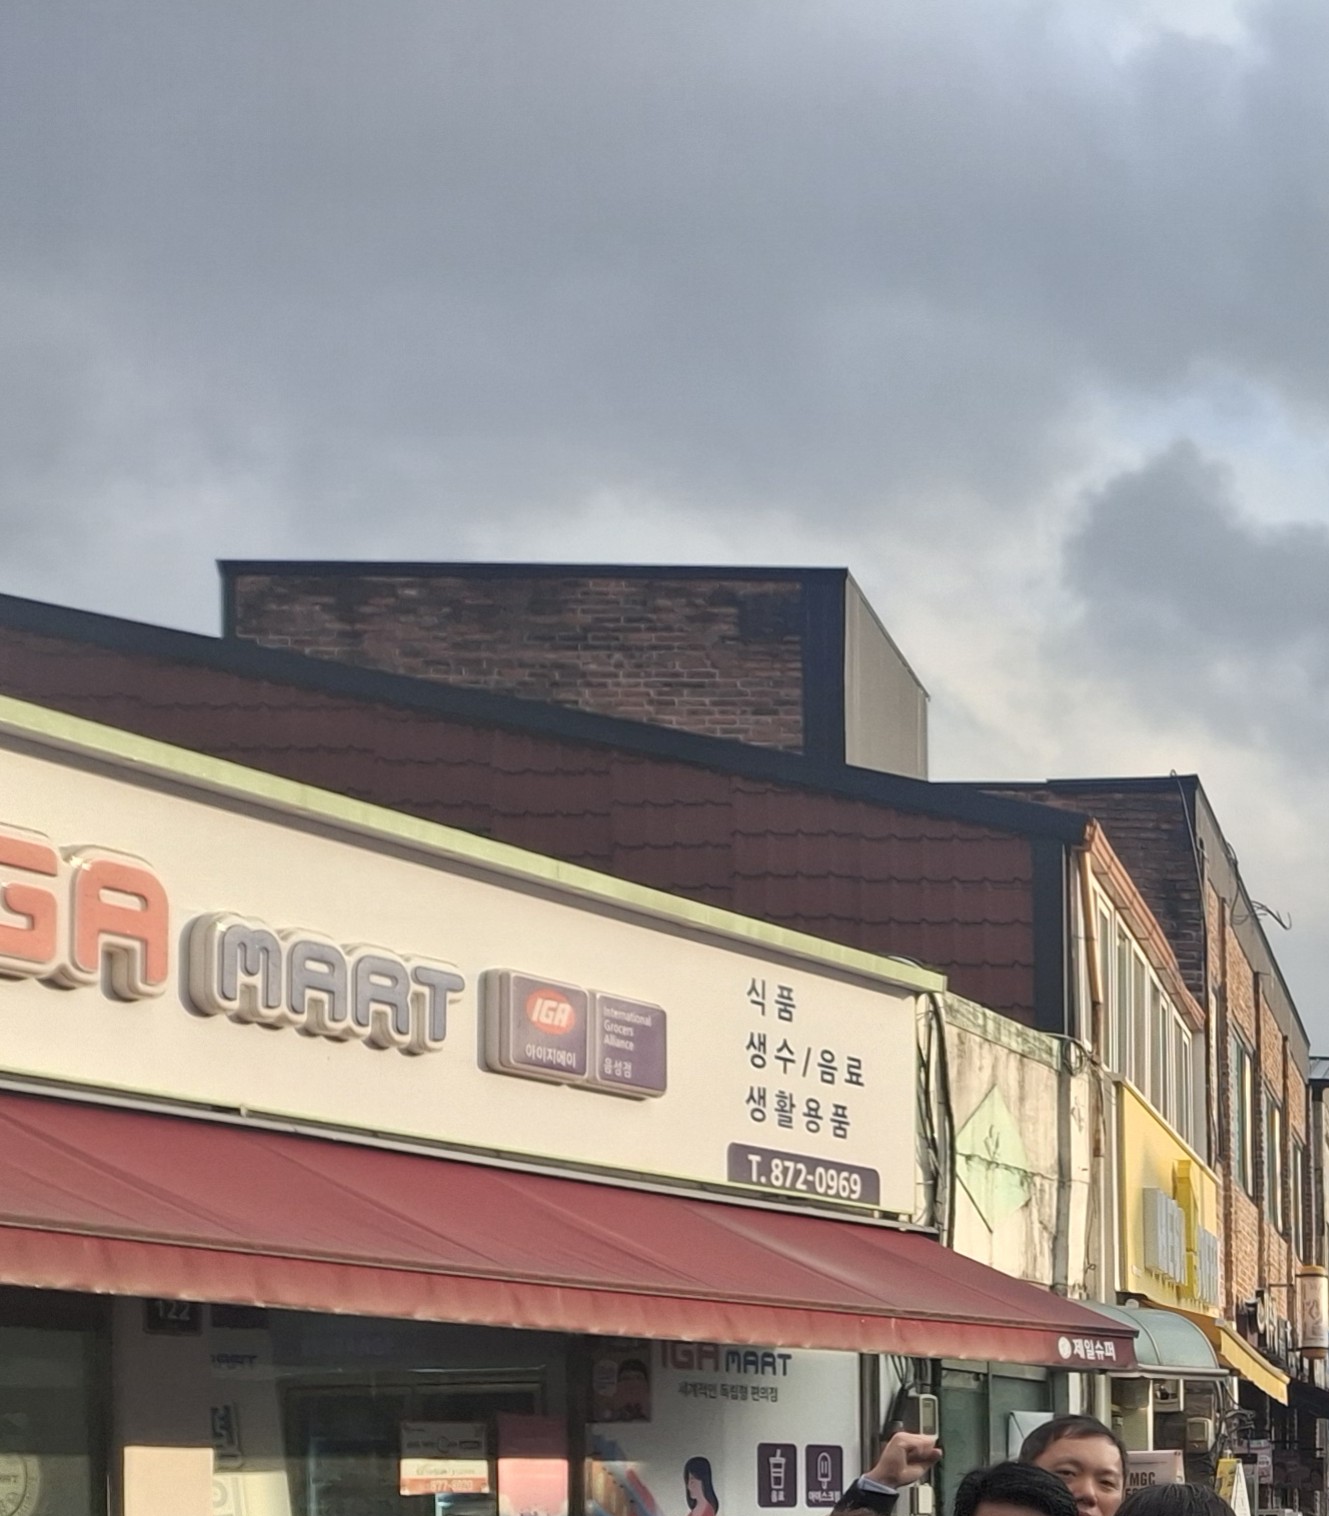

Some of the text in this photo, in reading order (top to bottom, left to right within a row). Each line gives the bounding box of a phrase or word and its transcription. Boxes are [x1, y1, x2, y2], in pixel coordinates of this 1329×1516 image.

[221, 924, 465, 1042] MART
[747, 978, 796, 1022] 식품
[532, 998, 571, 1027] IGA
[603, 1007, 652, 1026] International
[604, 1020, 634, 1037] Grocers
[604, 1034, 634, 1050] Alliance
[525, 1043, 576, 1068] 아이지에이
[745, 1031, 865, 1087] 생수/음료
[604, 1057, 632, 1078] 음성점
[745, 1086, 850, 1139] 생활용품
[1072, 1339, 1117, 1361] 제일슈퍼
[725, 1350, 792, 1376] MART
[678, 1381, 718, 1399] 세계적인
[750, 1385, 779, 1403] 편의점
[1129, 1472, 1155, 1485] MGC
